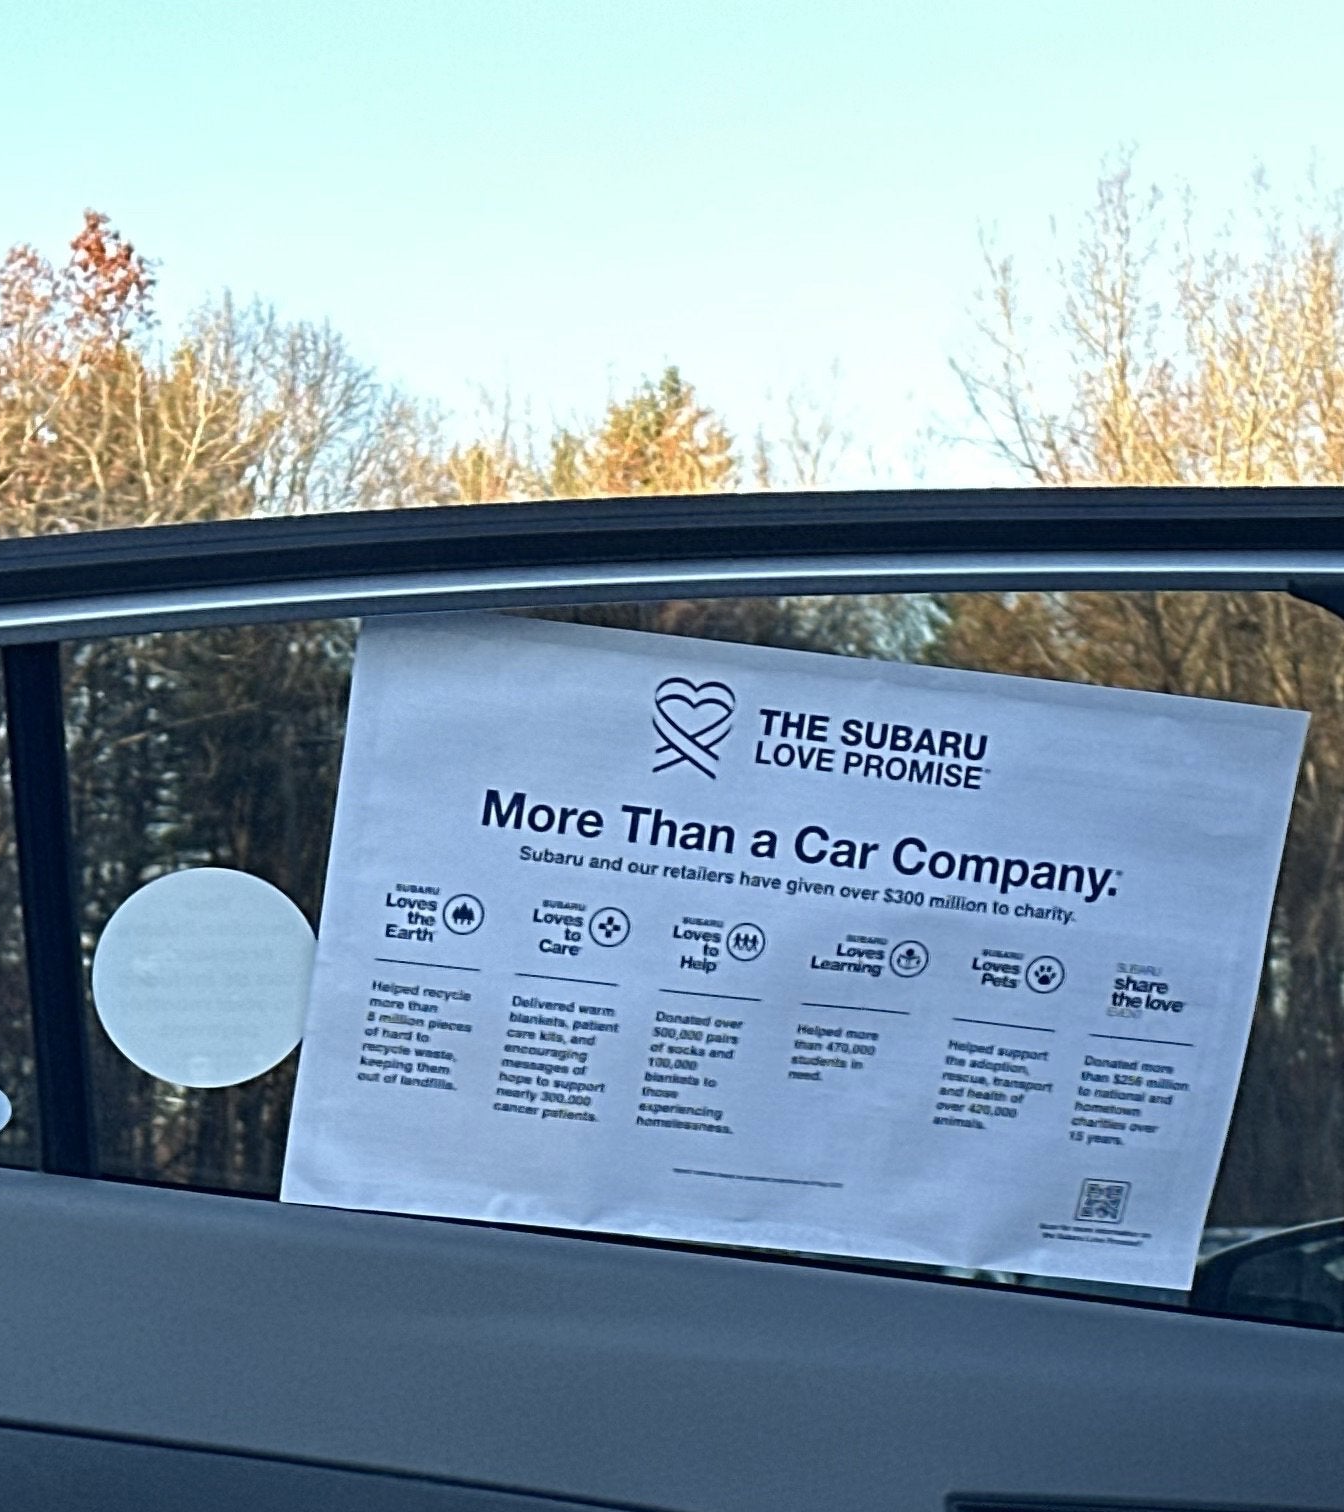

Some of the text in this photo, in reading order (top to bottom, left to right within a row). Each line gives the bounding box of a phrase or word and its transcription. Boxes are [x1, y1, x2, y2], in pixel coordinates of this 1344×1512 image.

[760, 709, 987, 761] THE SUBARU
[755, 741, 983, 790] LOVE PROMISE
[482, 789, 1121, 903] More Than a Car Company.
[396, 884, 440, 895] SUBARU
[520, 846, 1075, 925] Subaru and our retailers have given over $300 million to charity.
[386, 893, 437, 912] Loves
[542, 900, 586, 912] SUBARU
[407, 911, 436, 926] the
[533, 908, 584, 927] Loves
[385, 924, 434, 942] Earth
[564, 928, 581, 942] to
[673, 925, 721, 943] Loves
[539, 939, 581, 956] Care
[703, 943, 719, 957] to
[836, 943, 885, 960] Loves
[680, 955, 717, 974] Help
[811, 955, 883, 977] Learning
[972, 957, 1021, 975] Loves
[981, 972, 1019, 988] Pets
[1114, 976, 1168, 994] share
[372, 980, 471, 1001] Helped recycle
[369, 998, 438, 1013] more than
[512, 995, 615, 1017] Delivered warm
[1112, 991, 1184, 1012] the love
[428, 1020, 472, 1032] pieces
[572, 1020, 619, 1033] patient
[655, 1011, 743, 1029] Donated over
[364, 1027, 430, 1043] of hard to
[506, 1029, 536, 1039] care
[570, 1035, 596, 1046] and
[797, 1024, 879, 1041] Helped more
[362, 1043, 411, 1056] recycle
[504, 1044, 588, 1063] encouraging
[649, 1043, 665, 1052] of
[708, 1050, 734, 1059] and
[948, 1040, 1048, 1061] Helped support
[360, 1055, 450, 1075] keeping them
[501, 1059, 587, 1075] messages of
[851, 1059, 863, 1069] in
[945, 1055, 966, 1067] the
[1084, 1055, 1174, 1074] Donated more
[357, 1072, 380, 1082] out
[383, 1074, 398, 1083] of
[499, 1071, 605, 1093] hope to support
[703, 1078, 717, 1088] to
[1081, 1071, 1109, 1083] than
[496, 1087, 537, 1103] nearly
[939, 1087, 964, 1097] and
[1010, 1094, 1025, 1103] of
[1078, 1086, 1091, 1096] to
[1148, 1095, 1173, 1105] and
[493, 1102, 539, 1115] cancer
[638, 1103, 723, 1121] experiencing
[936, 1102, 965, 1112] over
[1129, 1123, 1159, 1133] over
